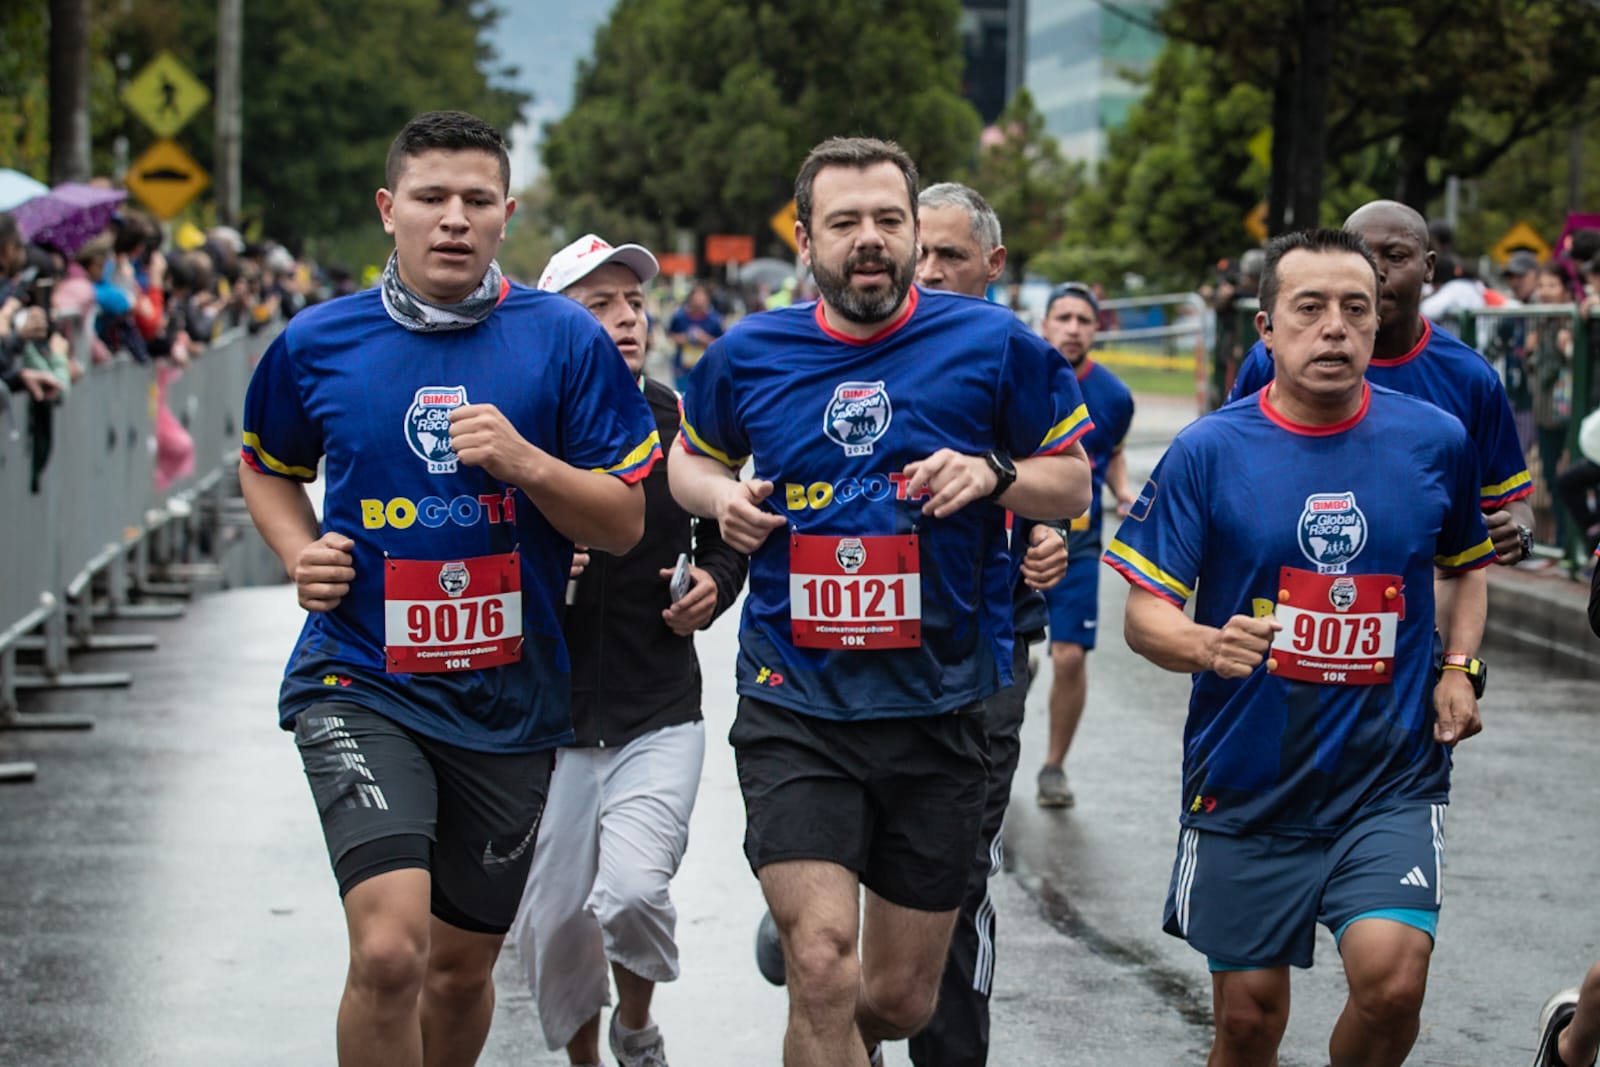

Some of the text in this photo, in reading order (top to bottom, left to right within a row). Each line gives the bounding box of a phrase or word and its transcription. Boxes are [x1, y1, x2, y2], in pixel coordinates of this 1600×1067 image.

[423, 395, 460, 404] BIMBO
[426, 409, 452, 420] Glo
[417, 419, 448, 431] Race
[848, 445, 871, 454] 2024
[1313, 501, 1348, 510] BIMBO
[1317, 514, 1356, 525] Global
[1309, 525, 1340, 536] Race
[1321, 565, 1344, 573] 2024
[802, 578, 905, 618] 10121
[407, 599, 504, 643] 9076
[1292, 613, 1382, 656] 9073
[841, 636, 866, 645] 10K
[445, 658, 471, 669] 10K
[755, 666, 784, 687] #9
[1322, 672, 1347, 682] 10K
